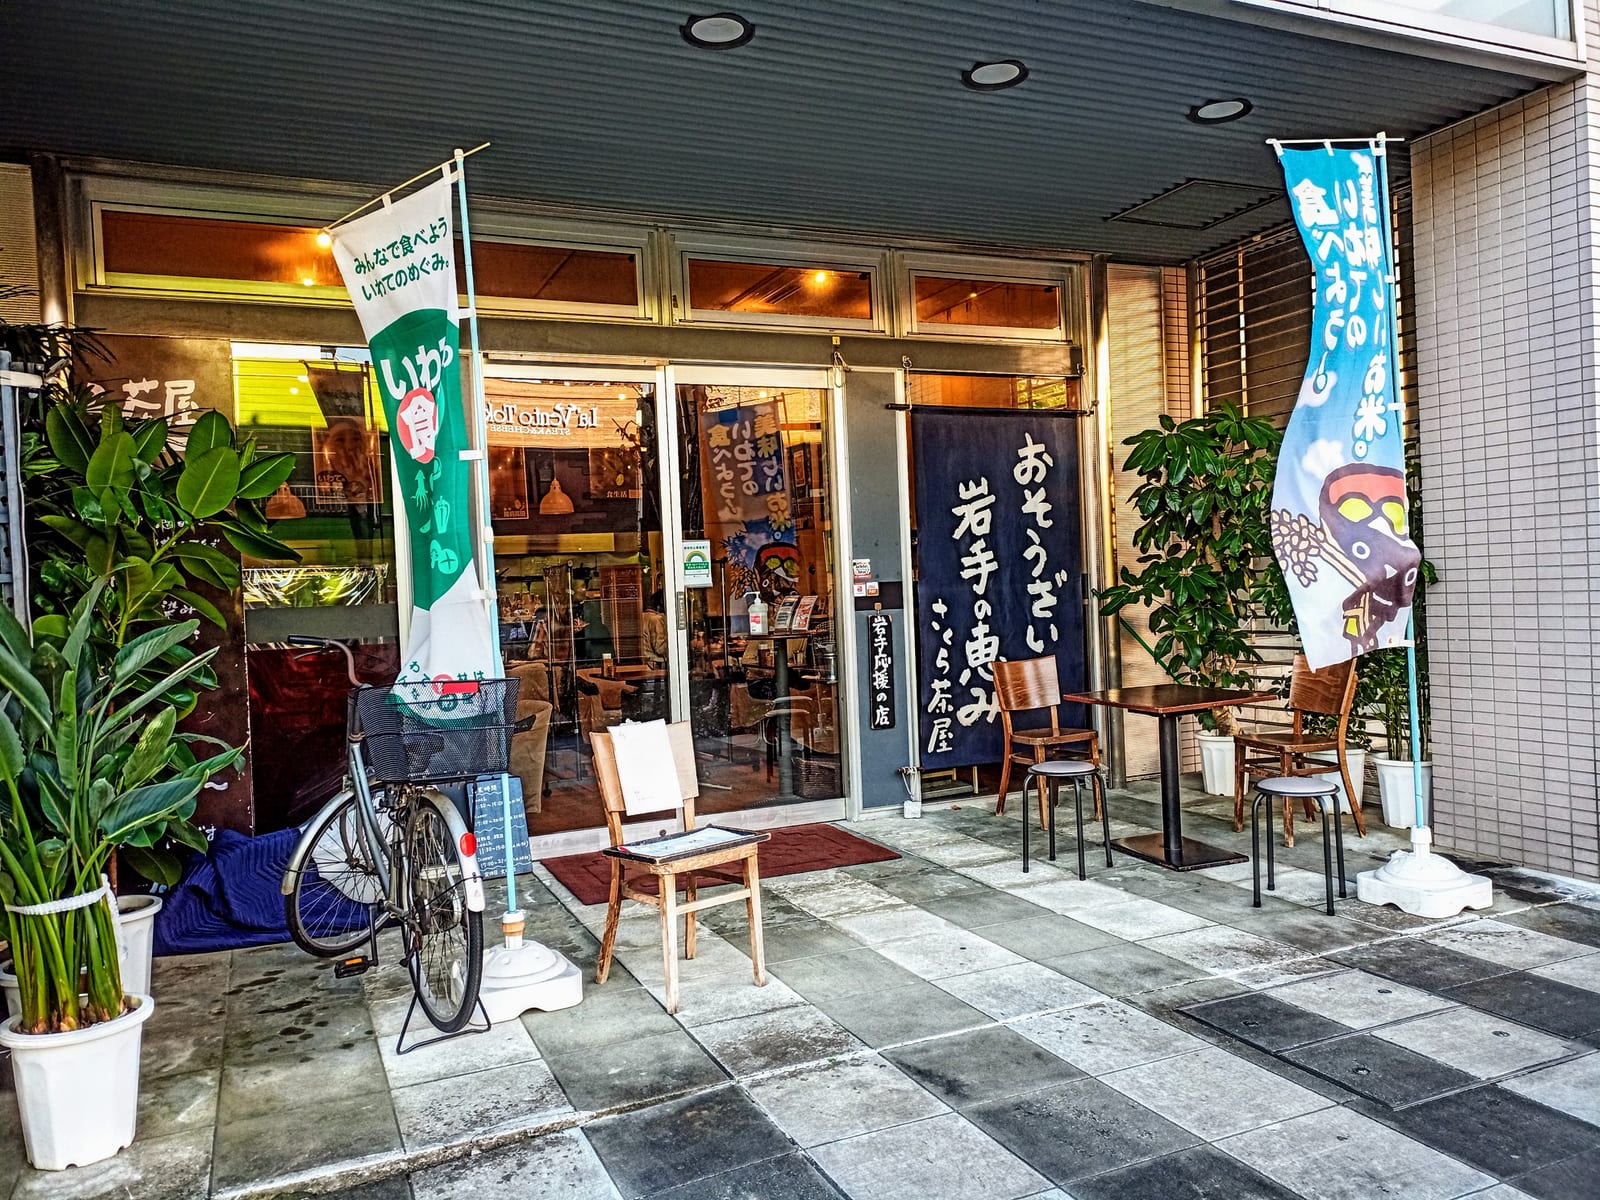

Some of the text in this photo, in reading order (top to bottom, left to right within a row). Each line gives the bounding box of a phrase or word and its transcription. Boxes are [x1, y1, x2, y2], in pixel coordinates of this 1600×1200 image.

[353, 216, 449, 276] みんなで食べよう
[361, 252, 450, 302] いわてのめぐみ。
[950, 475, 1009, 728] 岩手の恵み
[1012, 431, 1069, 655] おそうざい
[871, 614, 893, 727] 岩手応援の店
[926, 597, 955, 755] さくら茶屋
